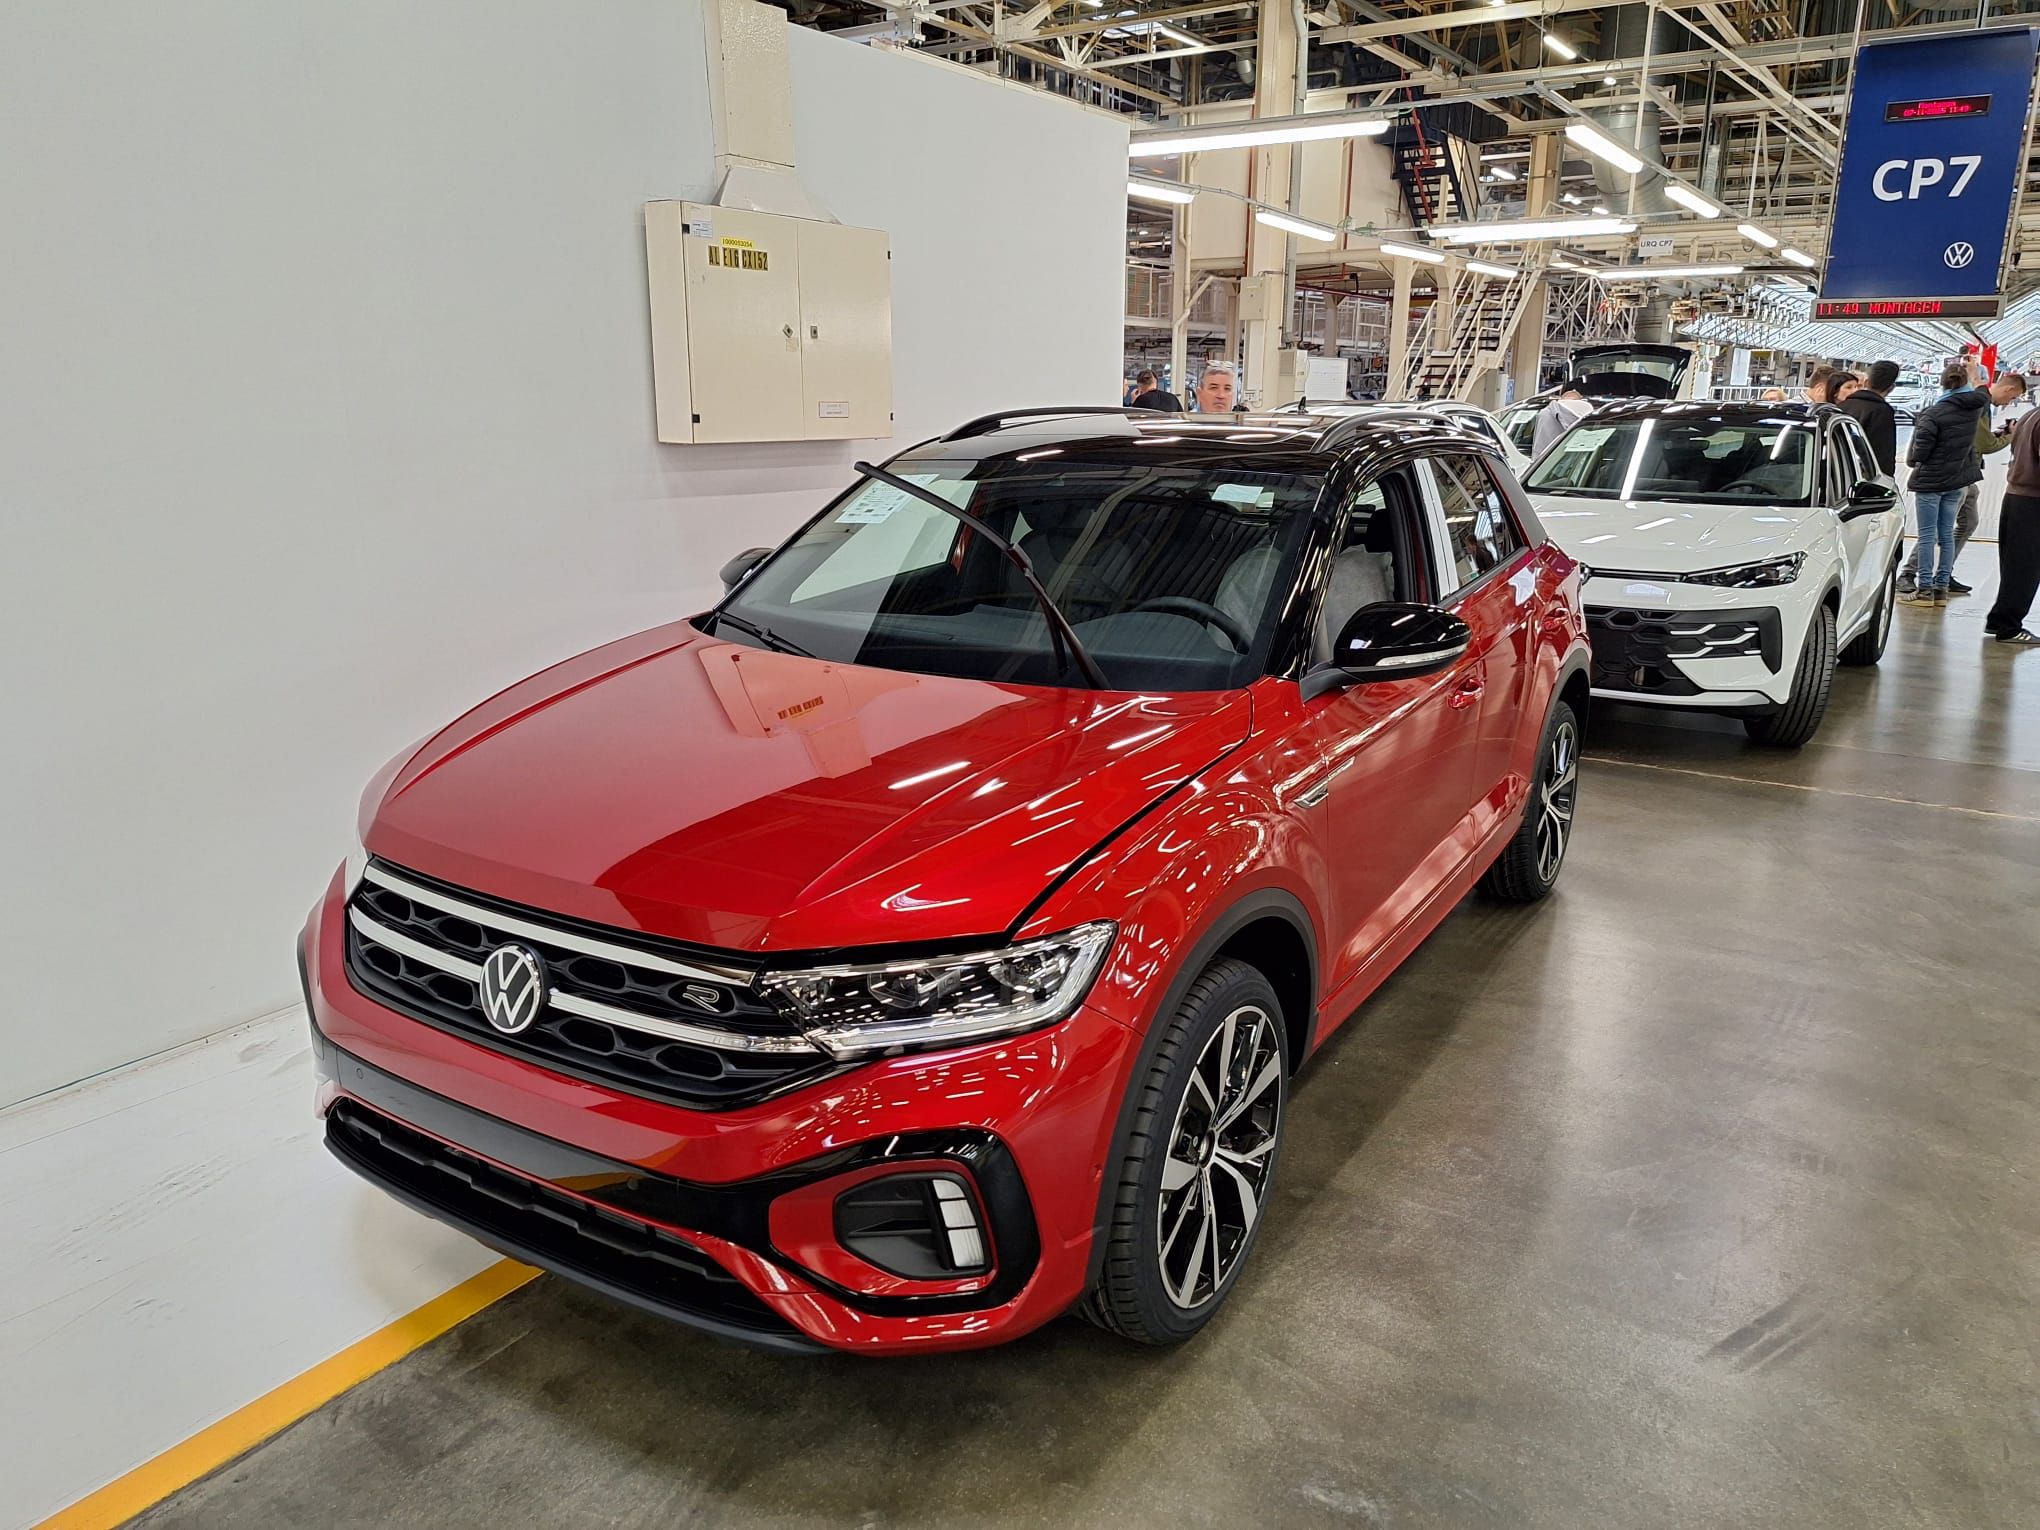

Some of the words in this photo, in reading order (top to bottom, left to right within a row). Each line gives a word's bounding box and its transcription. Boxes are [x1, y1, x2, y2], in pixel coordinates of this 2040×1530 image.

[1872, 155, 1982, 202] CP7
[1640, 240, 1658, 248] URQ
[1944, 241, 1974, 269] VW
[708, 246, 720, 266] AL
[723, 248, 740, 268] E16
[742, 250, 768, 271] CX152
[1818, 303, 1860, 316] 11:49
[480, 945, 543, 1034] VW
